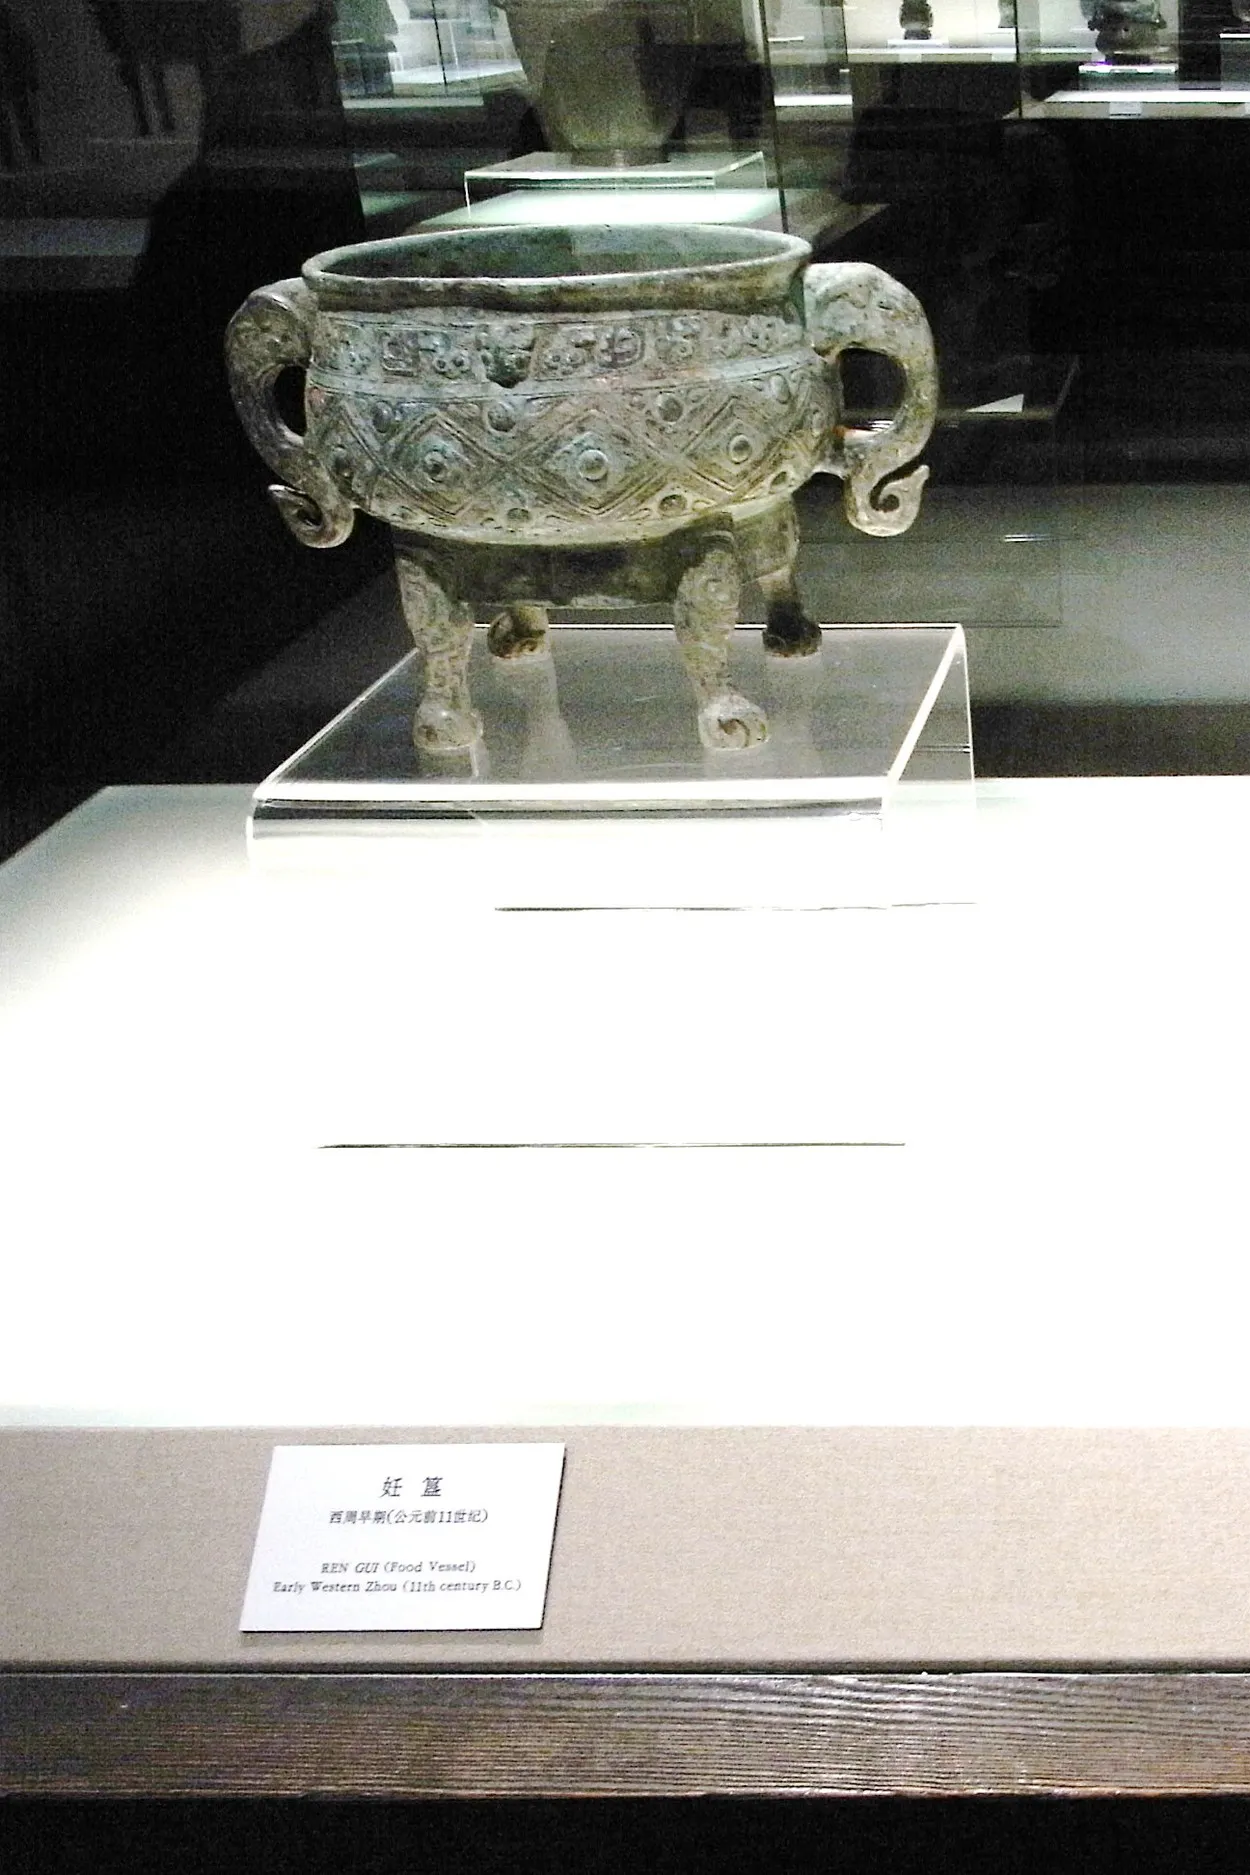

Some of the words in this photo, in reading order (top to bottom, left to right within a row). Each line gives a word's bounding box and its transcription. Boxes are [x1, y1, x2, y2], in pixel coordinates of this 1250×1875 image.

[320, 1562, 350, 1574] REN
[354, 1562, 380, 1574] GUI
[383, 1560, 423, 1573] (Food
[429, 1560, 477, 1573] Vessel)
[273, 1581, 306, 1595] Early
[310, 1581, 361, 1593] Western
[365, 1580, 398, 1593] Zhou
[402, 1579, 437, 1594] (11th
[439, 1582, 490, 1594] century
